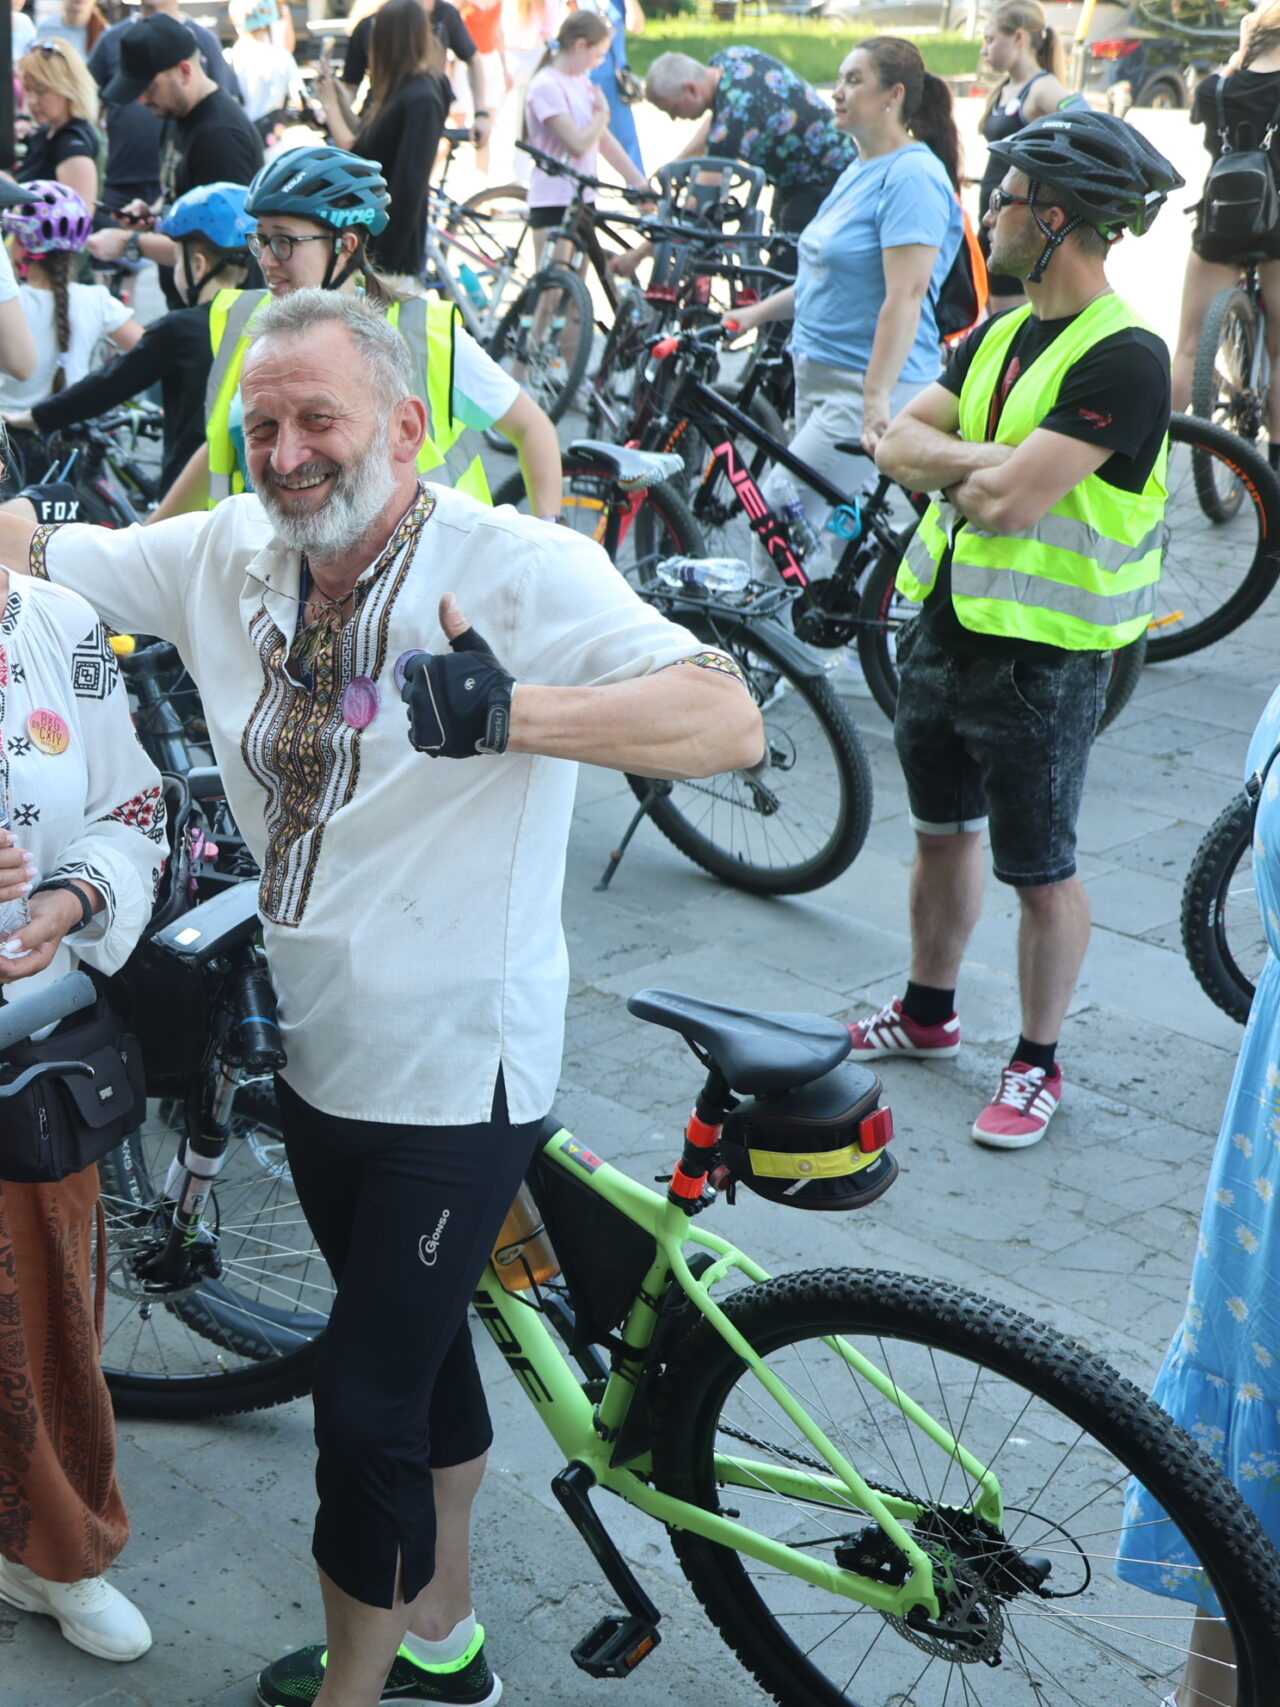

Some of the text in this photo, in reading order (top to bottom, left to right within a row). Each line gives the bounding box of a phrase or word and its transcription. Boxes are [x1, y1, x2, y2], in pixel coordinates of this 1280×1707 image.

[41, 501, 79, 520] FOX
[422, 1209, 450, 1257] GONSO
[472, 1290, 554, 1403] BE
